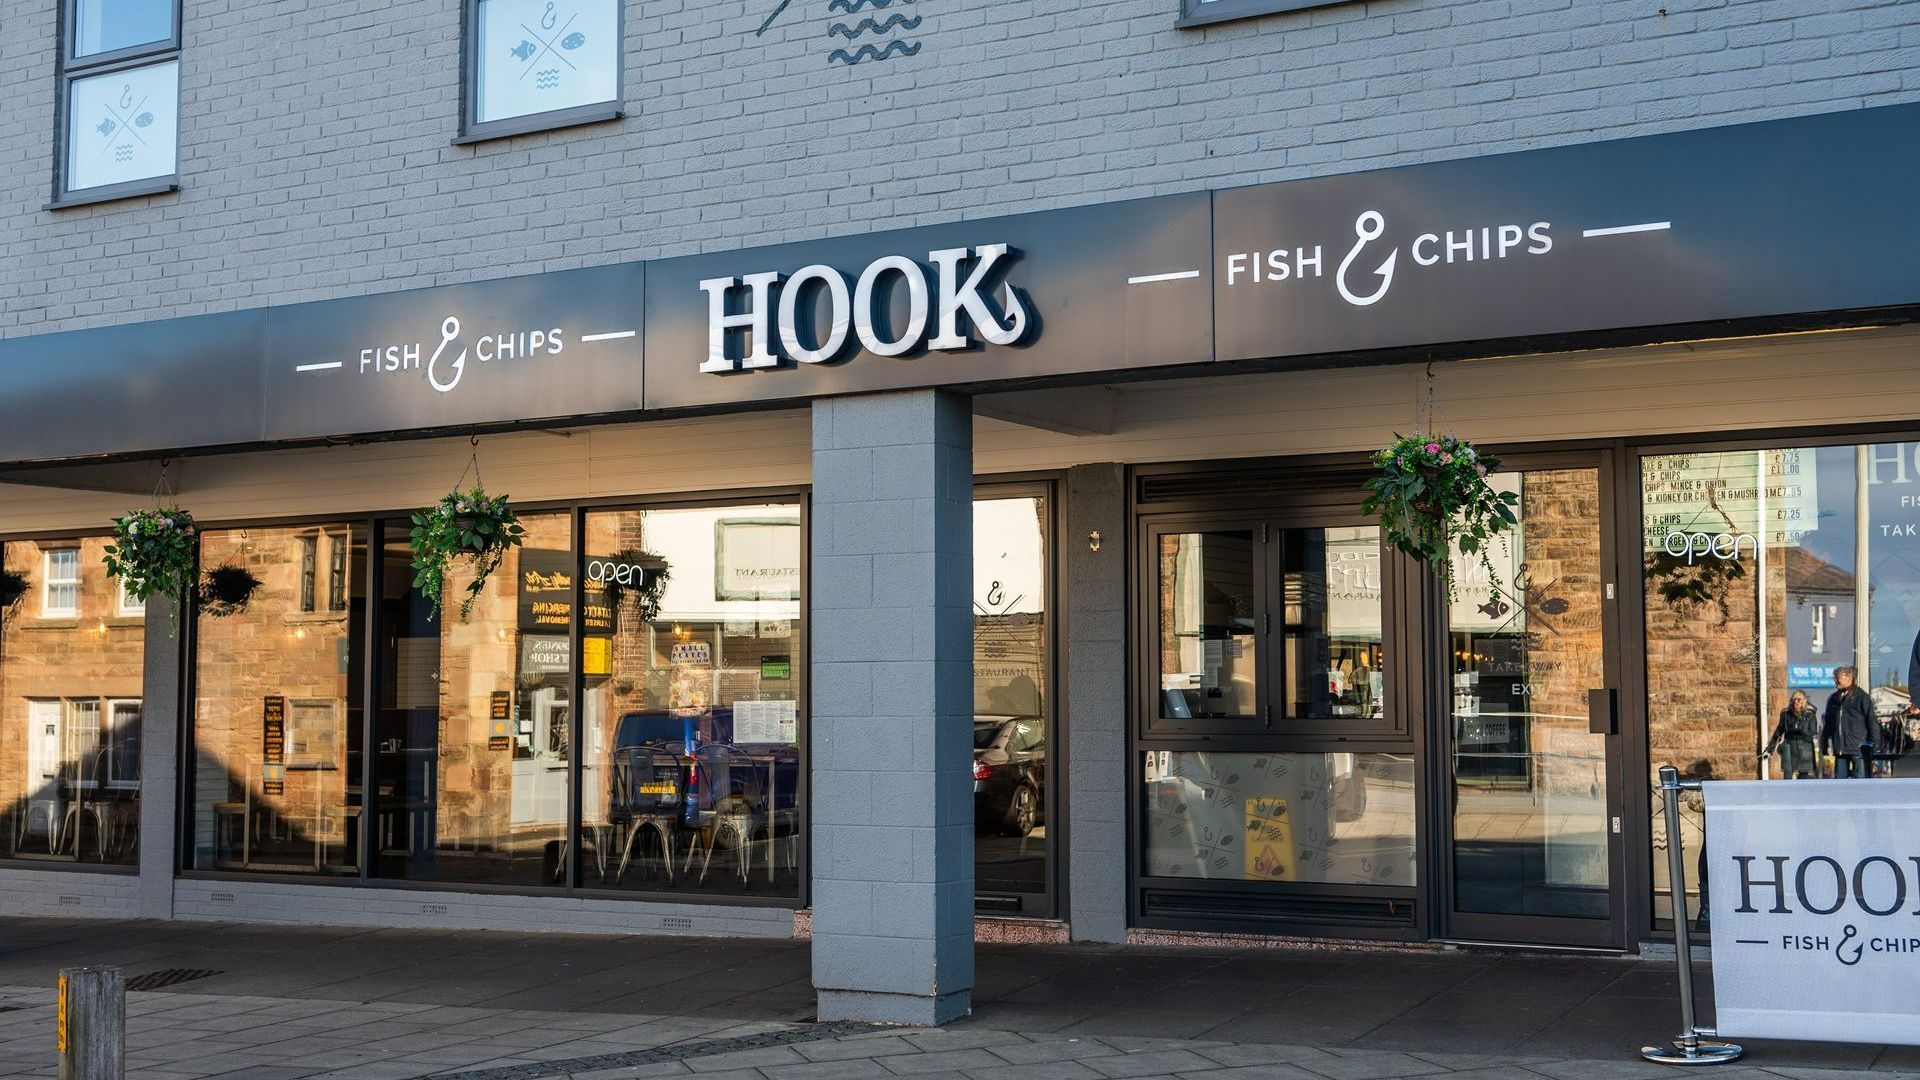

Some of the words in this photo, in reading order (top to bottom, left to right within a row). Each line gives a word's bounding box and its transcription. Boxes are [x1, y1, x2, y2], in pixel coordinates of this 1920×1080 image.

[1226, 245, 1323, 286] FISH
[1411, 221, 1553, 267] CHIPS
[699, 243, 1032, 374] HOOK
[360, 343, 420, 374] FISH
[475, 328, 564, 363] CHIPS
[1657, 460, 1663, 470] &
[1668, 459, 1690, 469] CHIPS
[1650, 472, 1656, 480] &
[1660, 471, 1681, 481] CHIPS
[1645, 482, 1665, 492] CHIPS
[1670, 481, 1693, 491] MINCE
[1696, 480, 1701, 489] &
[1704, 480, 1727, 489] ONION
[1647, 494, 1653, 503] &
[1655, 492, 1681, 502] KIDNEY
[1683, 492, 1693, 502] OR
[1728, 491, 1733, 499] &
[1652, 515, 1658, 524] &
[1660, 514, 1681, 525] CHIPS
[1665, 531, 1758, 565] open
[587, 560, 644, 588] open
[1782, 935, 1829, 951] FISH
